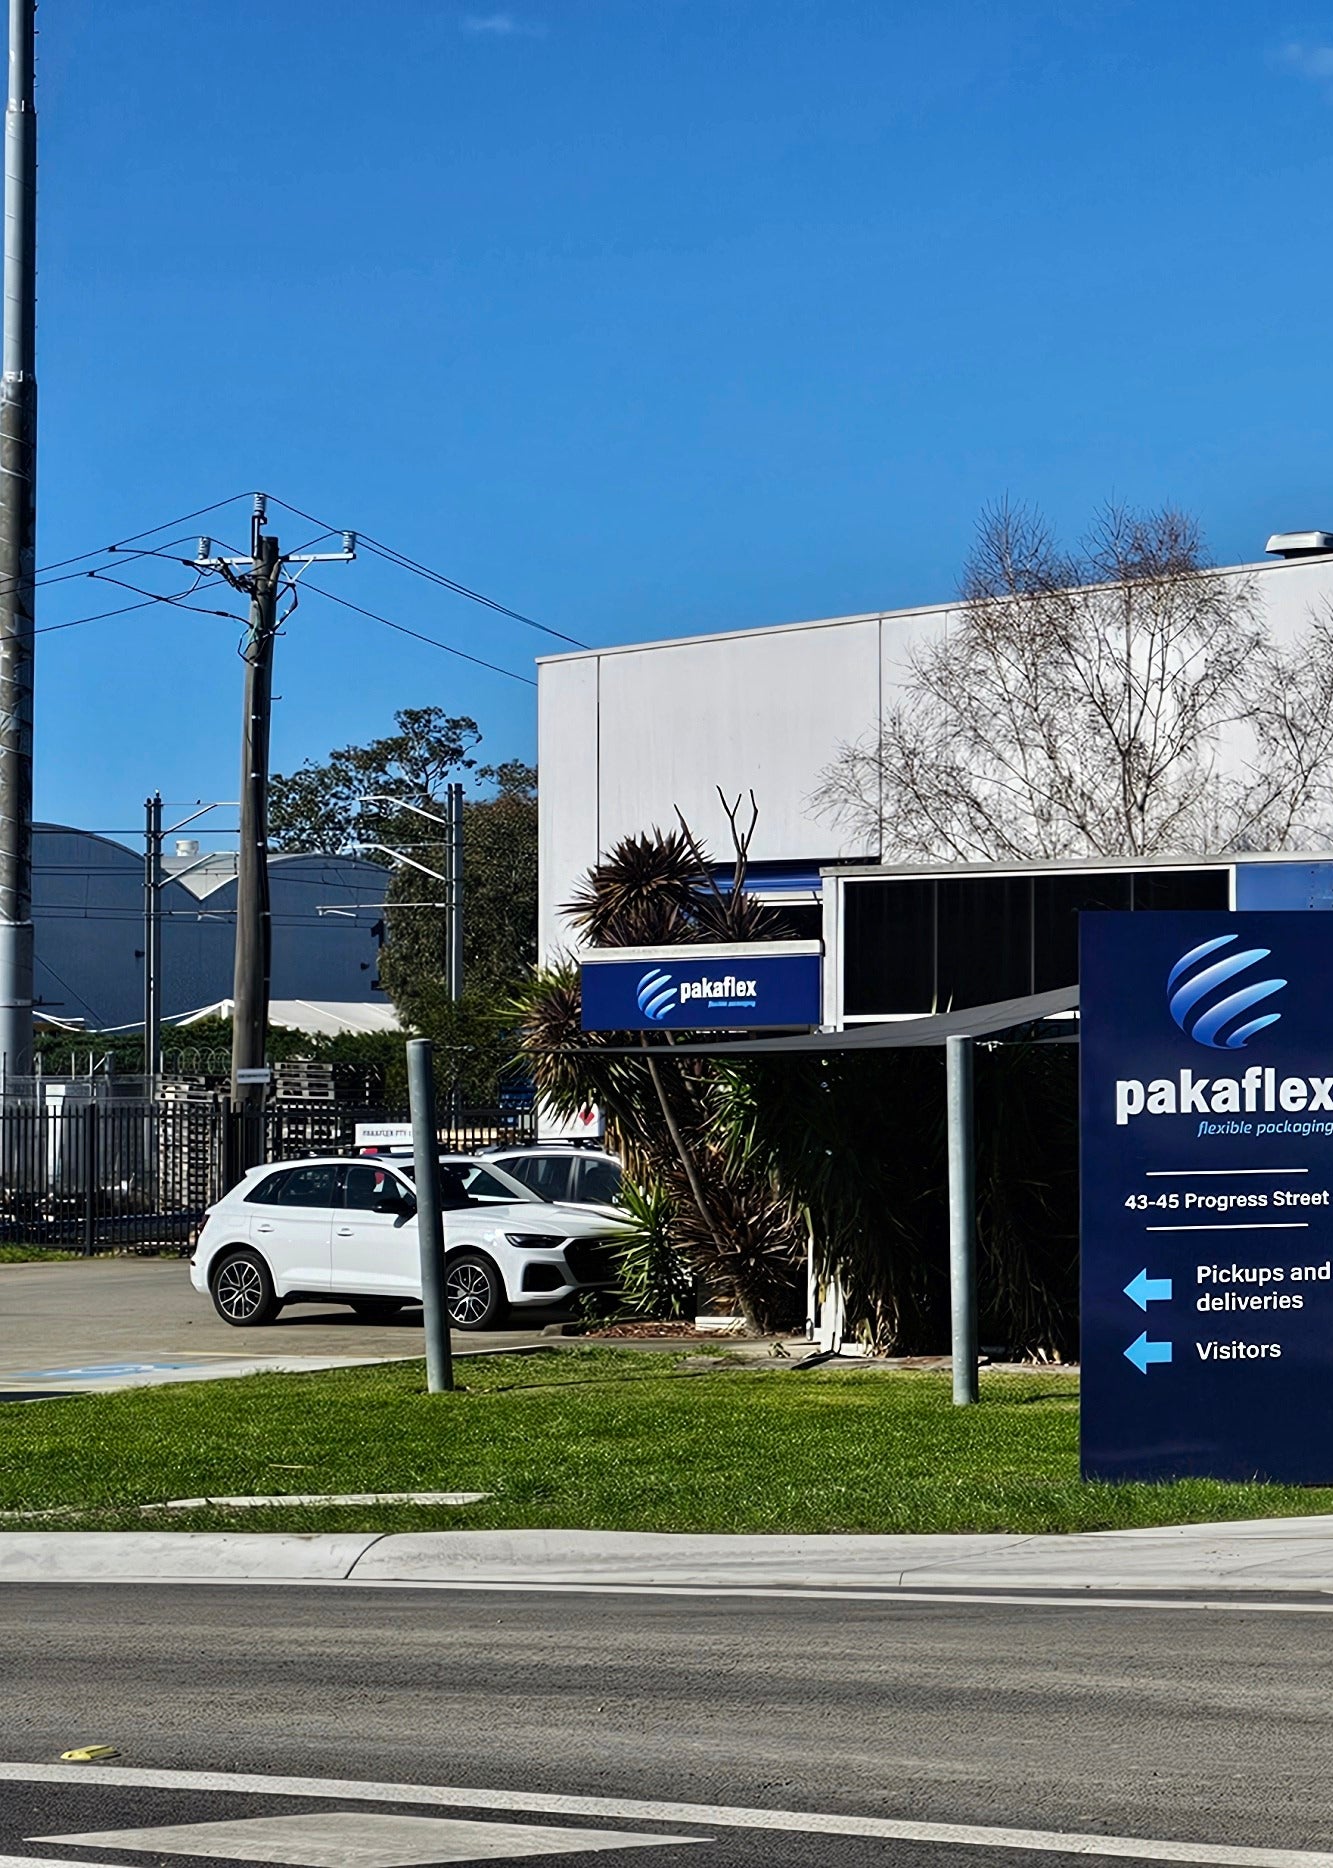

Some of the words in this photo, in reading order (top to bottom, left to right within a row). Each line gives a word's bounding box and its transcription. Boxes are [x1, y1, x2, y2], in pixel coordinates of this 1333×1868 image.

[680, 976, 757, 1003] pakaflex
[1197, 1120, 1252, 1137] flexible
[1124, 1194, 1180, 1210] 43-45
[1185, 1192, 1268, 1212] Progress
[1273, 1190, 1330, 1207] Street
[1196, 1264, 1284, 1287] Pickups
[1290, 1262, 1331, 1281] and
[1196, 1292, 1304, 1312] deliveries
[1196, 1341, 1282, 1361] Visitors
